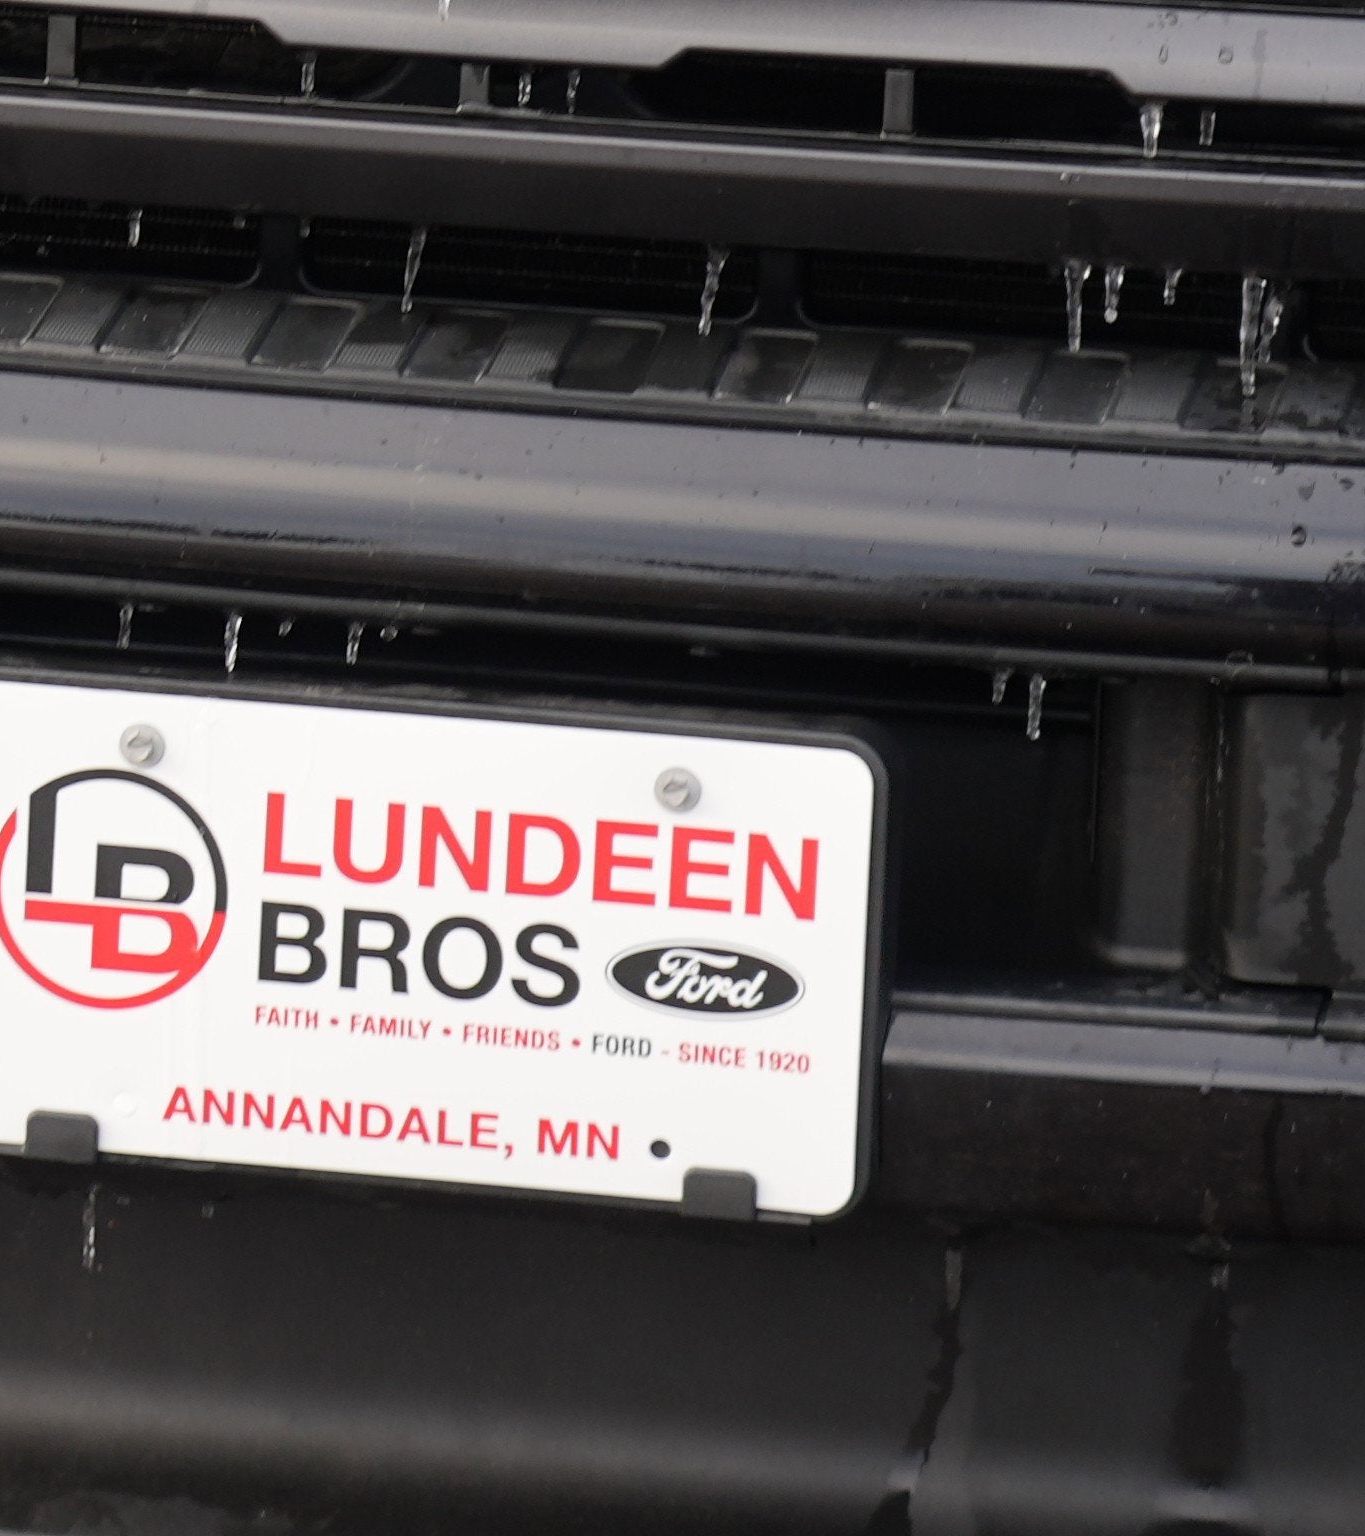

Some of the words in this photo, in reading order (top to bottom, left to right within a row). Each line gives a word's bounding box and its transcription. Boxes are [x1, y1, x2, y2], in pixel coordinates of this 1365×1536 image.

[263, 792, 819, 921] LUNDEEN
[257, 900, 581, 1008] BROS
[644, 947, 768, 1009] Ford
[254, 1005, 319, 1030] FAITH
[349, 1013, 431, 1040] FAMILY
[462, 1023, 561, 1051] FRIENDS
[591, 1034, 653, 1059] FORD
[678, 1042, 747, 1068] SINCE
[756, 1050, 811, 1074] 1920
[162, 1085, 514, 1159] ANNANDALE,
[537, 1118, 620, 1161] MN
